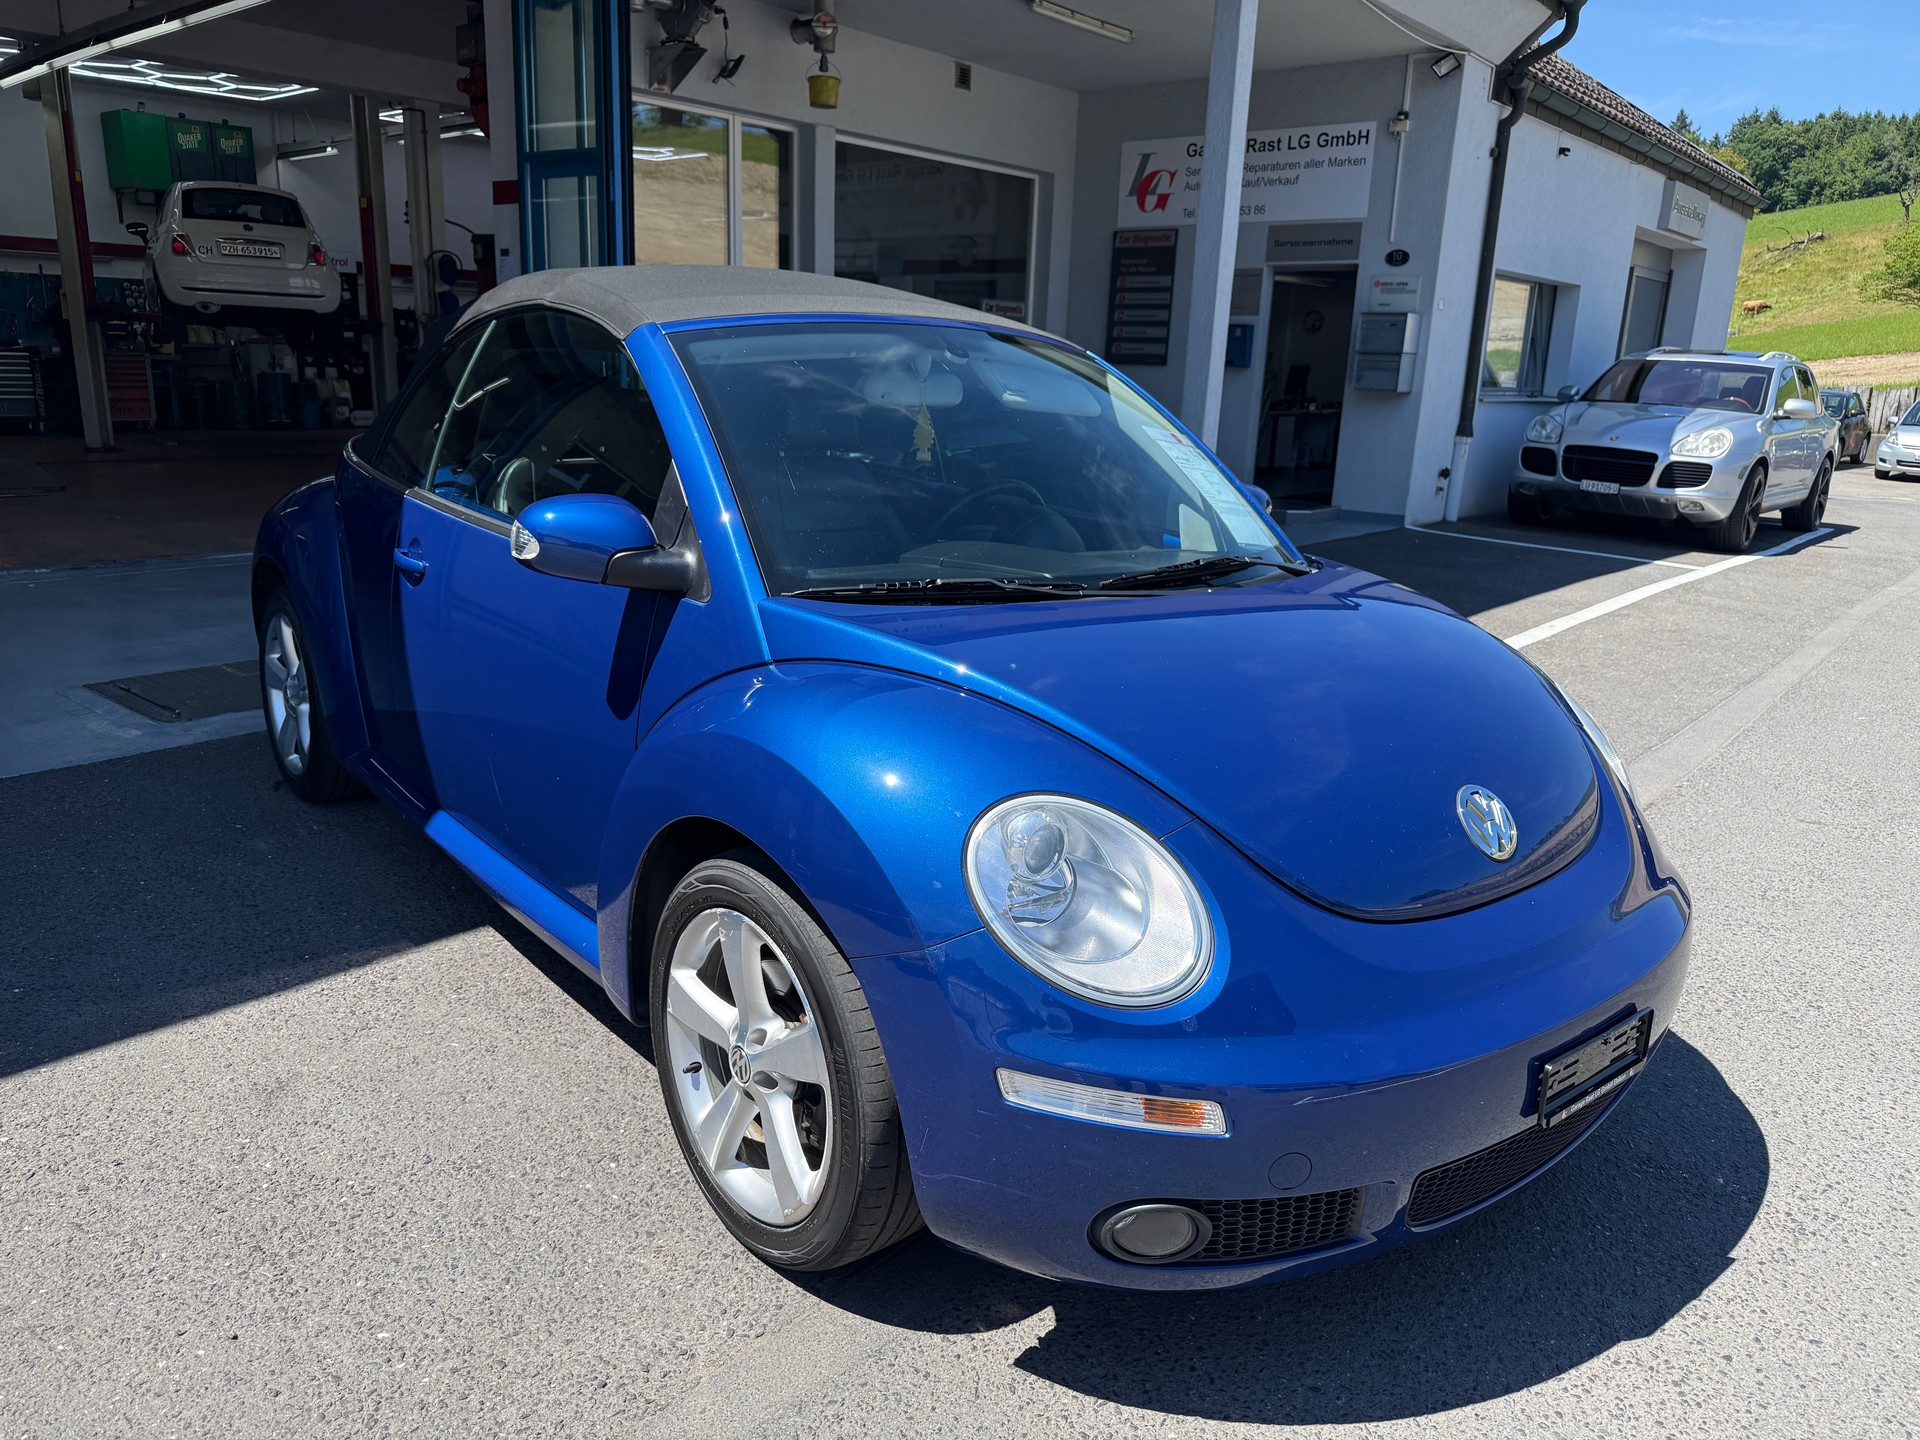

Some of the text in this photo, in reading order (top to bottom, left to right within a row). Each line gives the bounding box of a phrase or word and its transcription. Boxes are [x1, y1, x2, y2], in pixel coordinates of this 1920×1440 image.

[177, 132, 202, 145] QUAKER
[220, 138, 244, 150] QUAKER
[1186, 129, 1370, 158] Ga Rast LG GmbH
[182, 140, 199, 150] STATE
[225, 147, 241, 155] STATE
[1184, 156, 1367, 177] Ser Reparaturen aller Marken
[1183, 181, 1201, 192] Aut
[1253, 204, 1266, 215] 86
[1273, 237, 1354, 248] Serviceannahme
[198, 245, 213, 255] CH
[331, 257, 348, 267] trol
